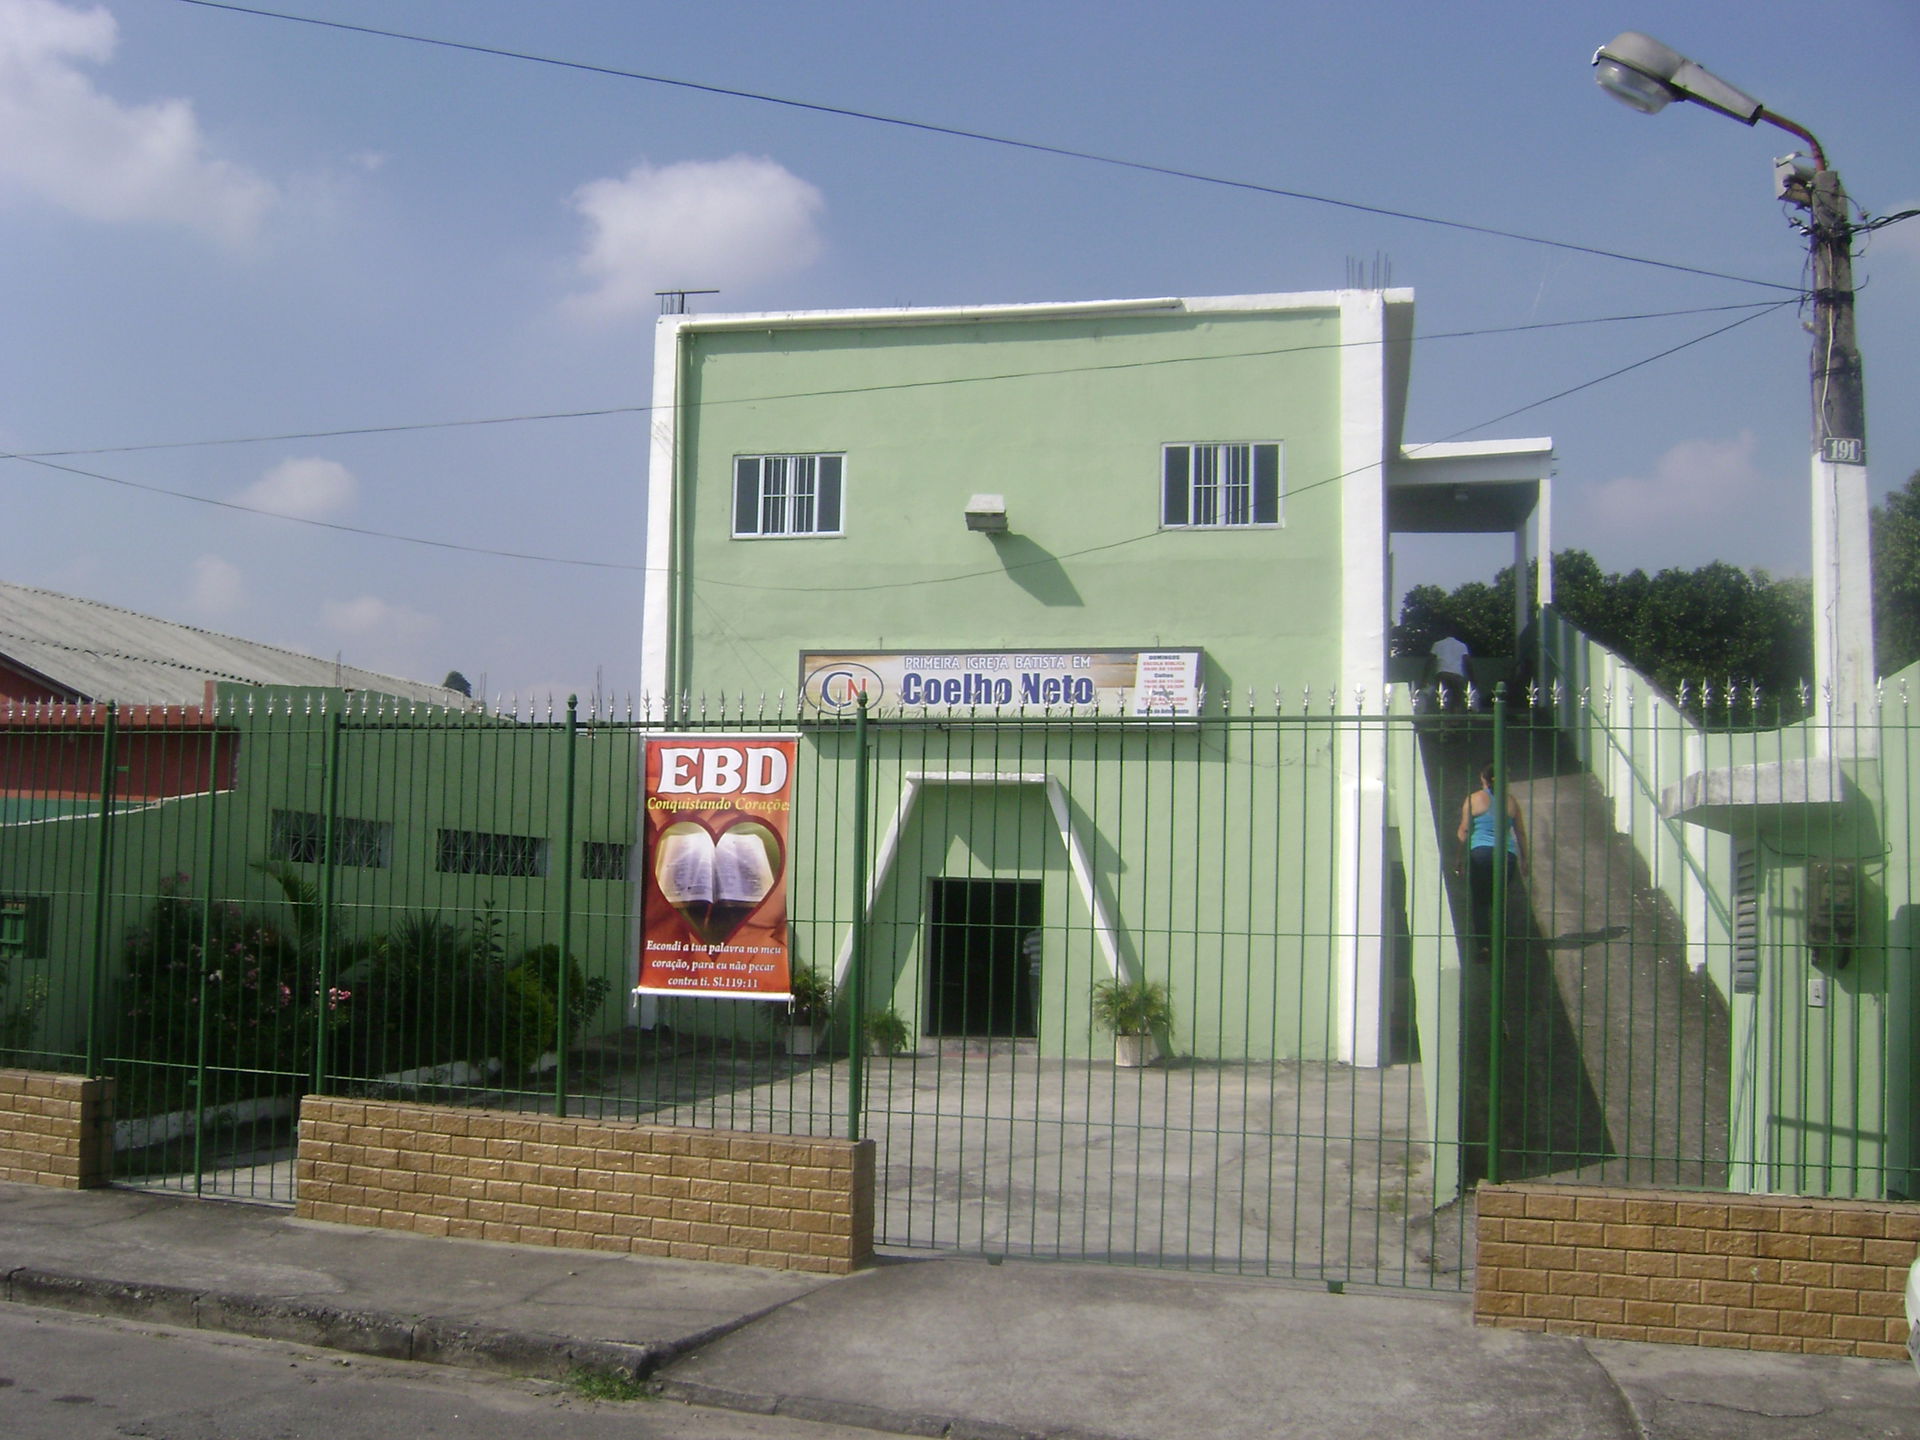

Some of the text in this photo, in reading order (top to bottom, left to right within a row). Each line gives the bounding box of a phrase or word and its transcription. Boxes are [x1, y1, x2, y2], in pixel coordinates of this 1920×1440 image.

[1831, 440, 1856, 459] 191
[904, 655, 1091, 672] PRIMEIRA IGREJA BATISTA EM
[903, 673, 1093, 705] Coelho Neto
[656, 747, 788, 795] EBD
[647, 797, 731, 813] Conquistando
[646, 940, 782, 955] Escondi a tua palavra no meu
[652, 959, 775, 973] coração, para eu não pecar
[667, 976, 758, 988] contra ti. Sl.119:11
